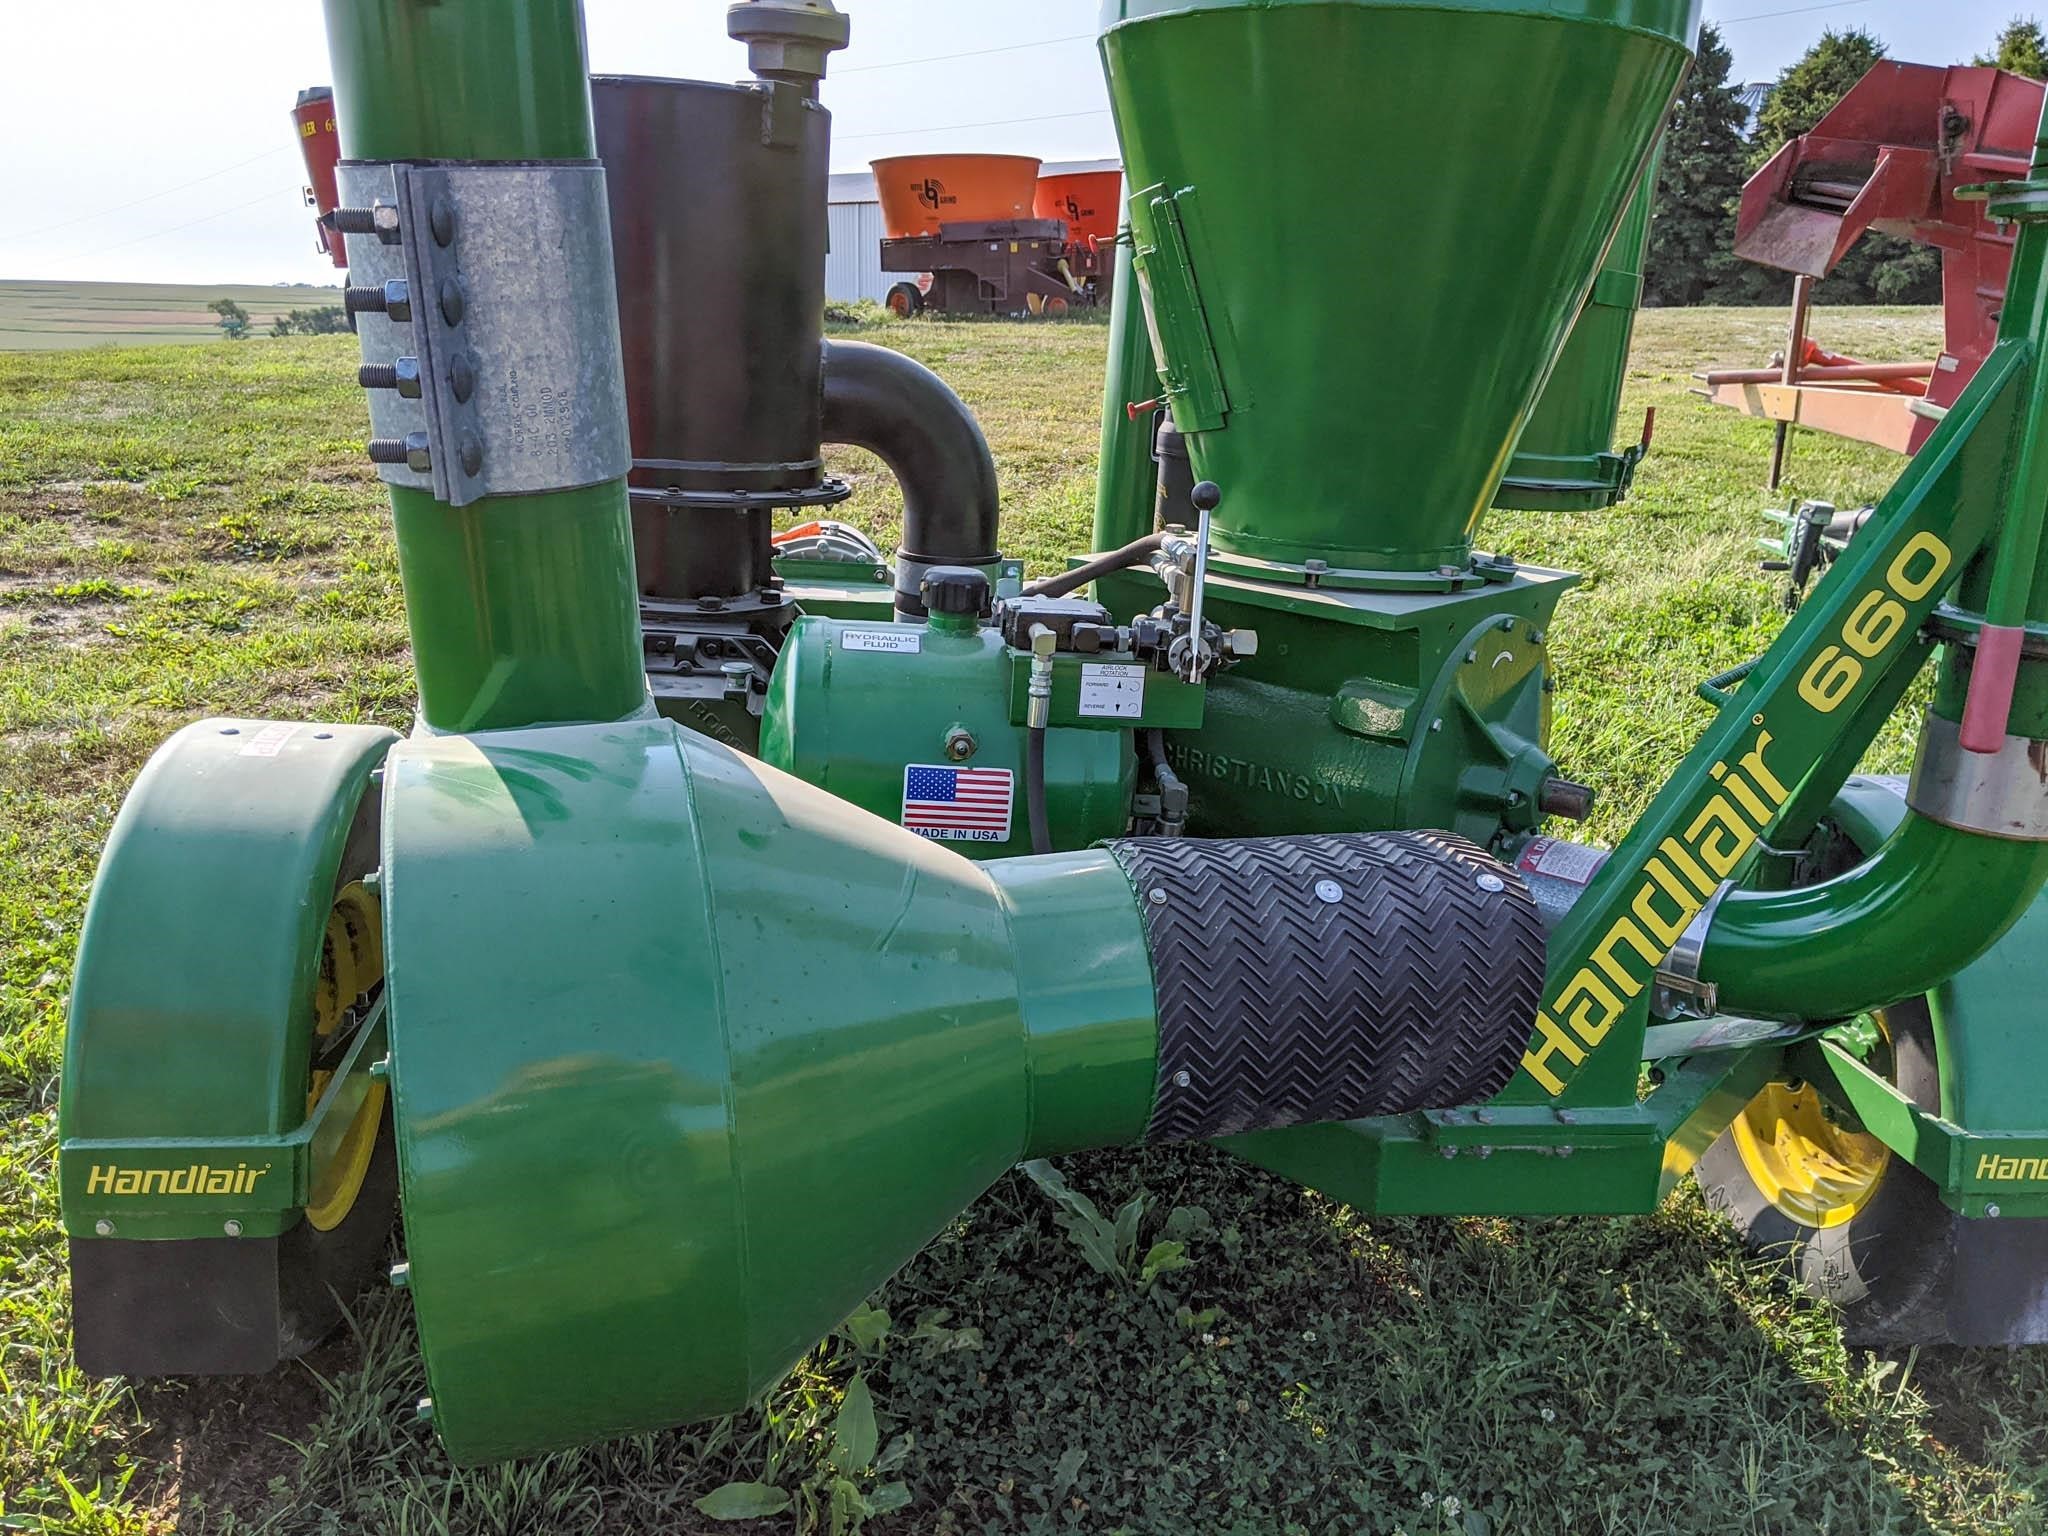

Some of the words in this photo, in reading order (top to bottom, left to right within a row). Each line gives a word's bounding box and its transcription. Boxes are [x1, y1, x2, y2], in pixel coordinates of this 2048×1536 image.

[1797, 531, 1952, 713] 660
[845, 632, 918, 643] HYDRAULIC
[863, 641, 899, 649] FLUID
[909, 827, 949, 839] MADE
[953, 829, 968, 839] IN
[972, 830, 999, 841] USA
[1519, 728, 1791, 1097] Handlair
[86, 1163, 267, 1195] Handlair
